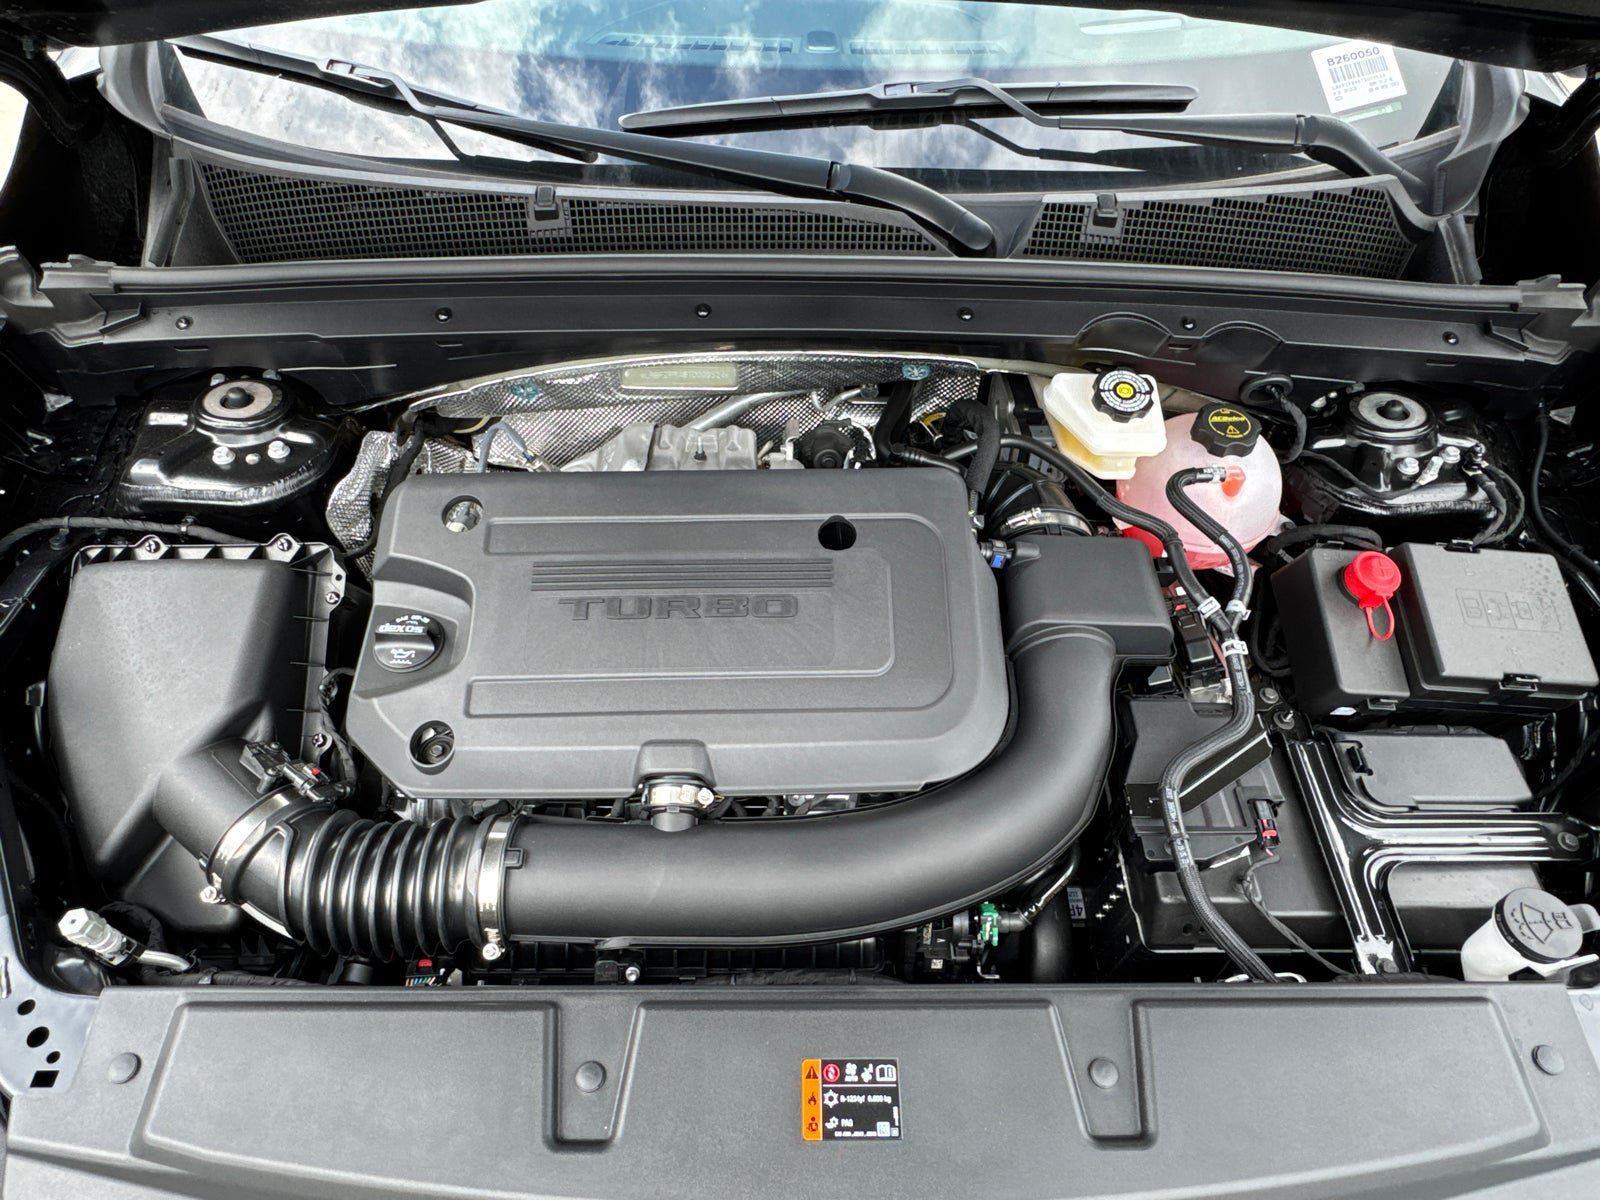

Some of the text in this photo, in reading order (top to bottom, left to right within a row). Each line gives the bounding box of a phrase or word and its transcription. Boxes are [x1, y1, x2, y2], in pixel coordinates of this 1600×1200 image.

[1326, 47, 1380, 66] B260050
[558, 594, 799, 620] TURBO
[378, 622, 425, 634] dexos
